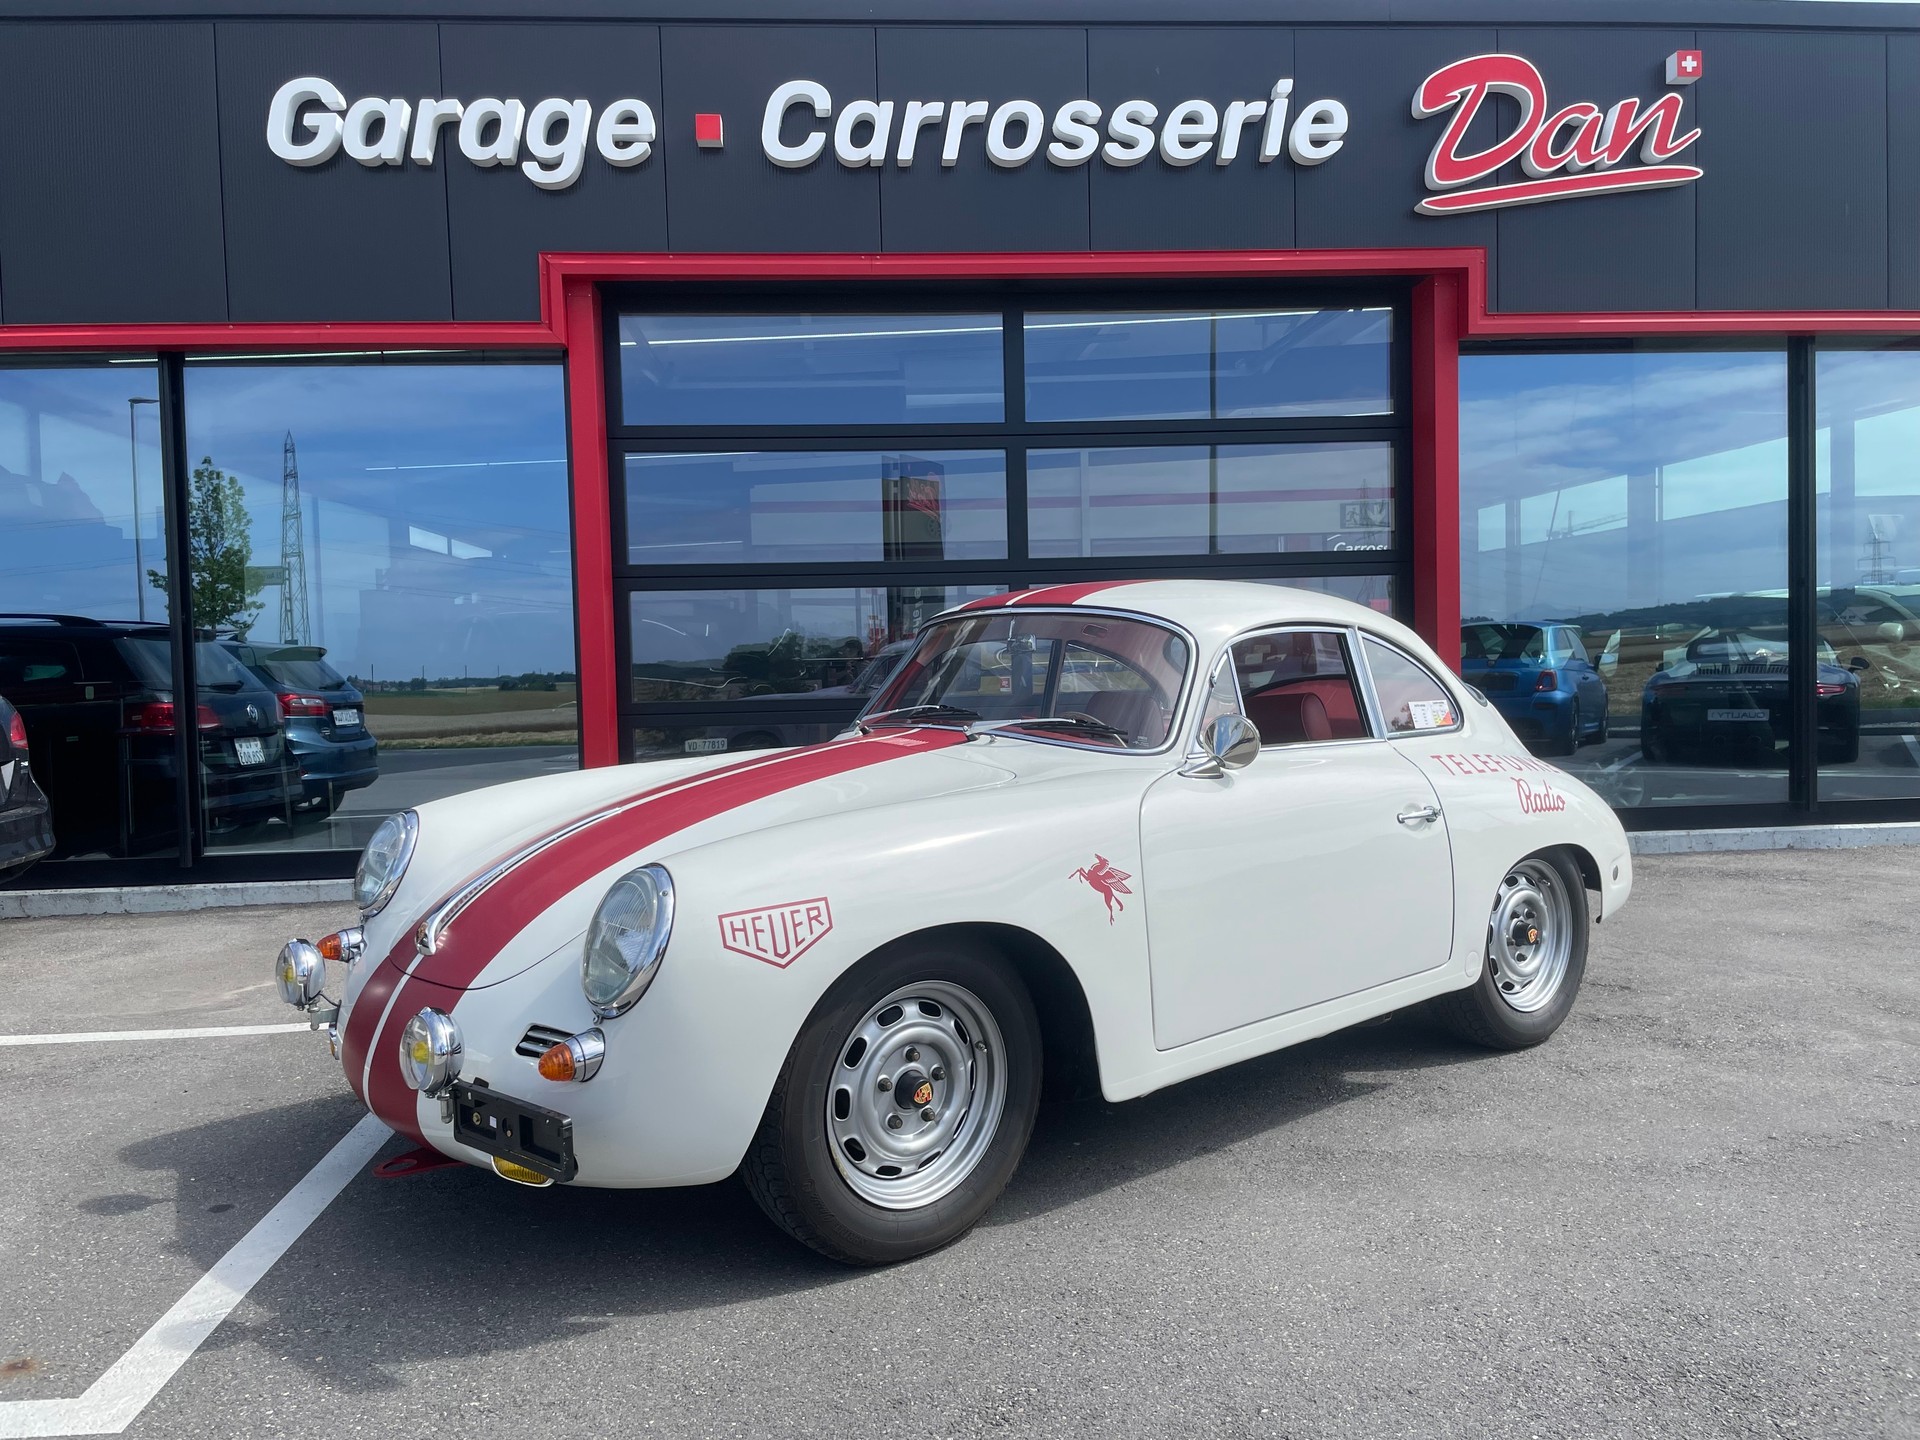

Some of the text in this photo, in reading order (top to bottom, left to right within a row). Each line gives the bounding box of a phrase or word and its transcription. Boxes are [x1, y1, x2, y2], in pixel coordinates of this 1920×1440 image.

[267, 50, 1702, 192] Garage Carrosserie Dani
[688, 740, 725, 751] VD 77819
[1510, 776, 1566, 815] Radio
[729, 905, 825, 960] HEUER
